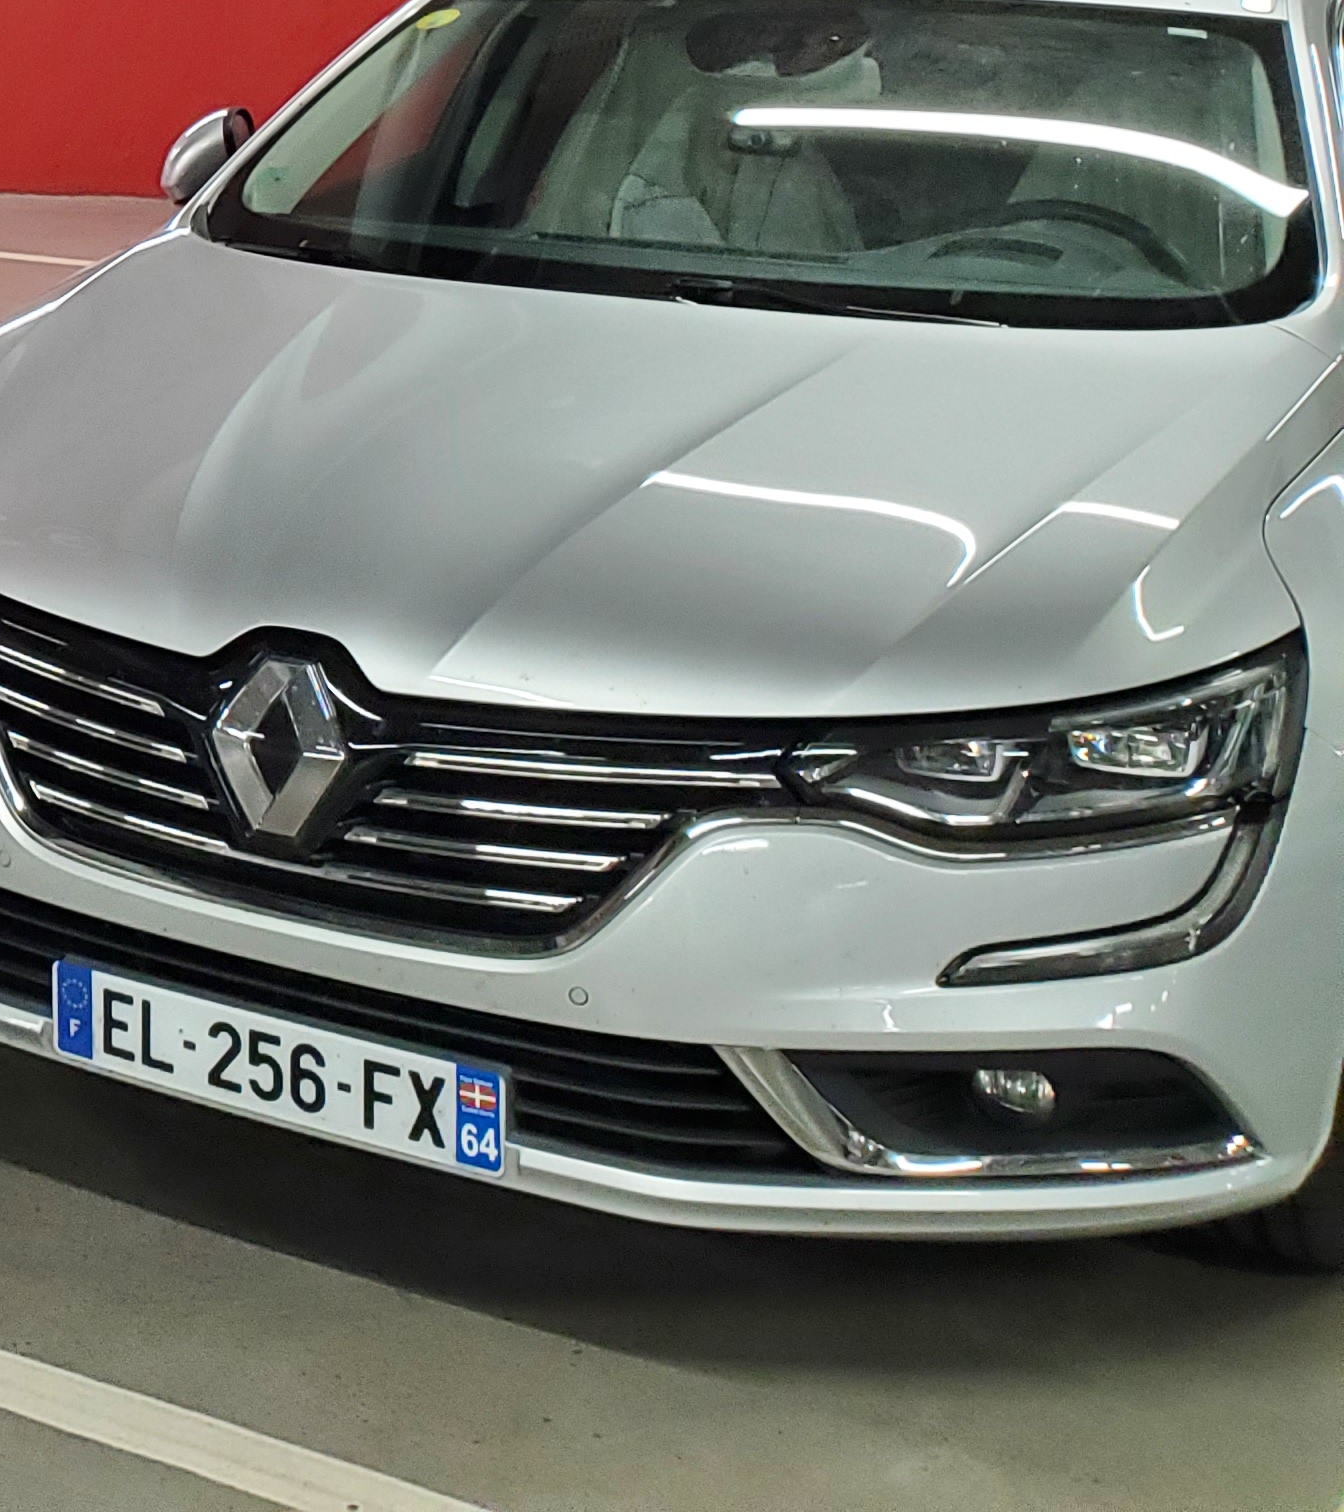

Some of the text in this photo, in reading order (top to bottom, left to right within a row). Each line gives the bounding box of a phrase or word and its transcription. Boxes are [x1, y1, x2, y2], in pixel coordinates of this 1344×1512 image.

[68, 987, 499, 1164] F EL-256-FX 64
